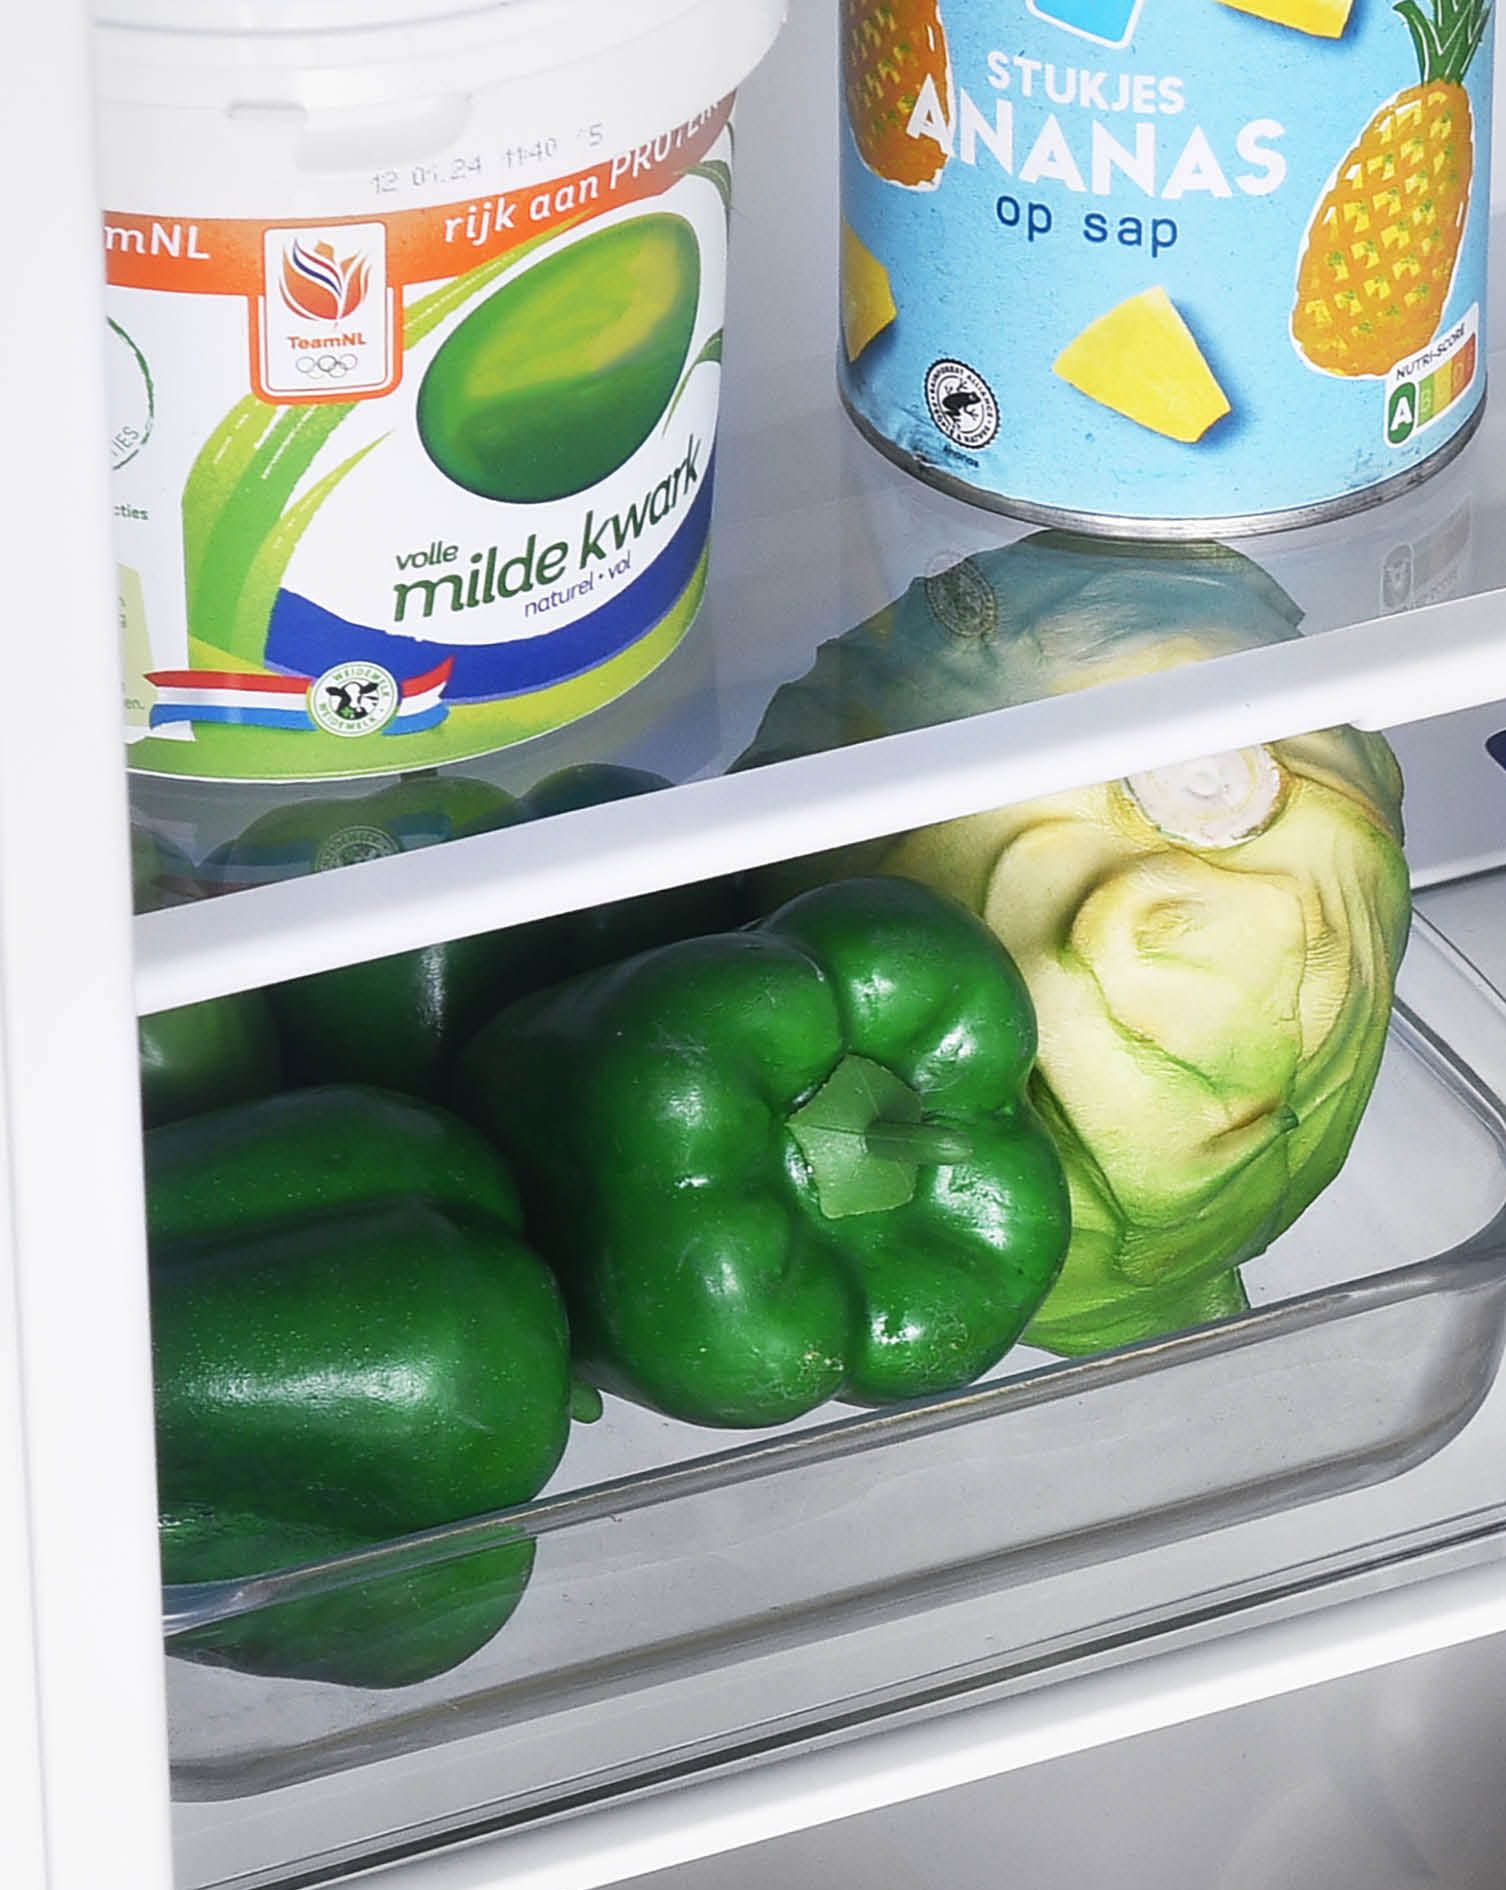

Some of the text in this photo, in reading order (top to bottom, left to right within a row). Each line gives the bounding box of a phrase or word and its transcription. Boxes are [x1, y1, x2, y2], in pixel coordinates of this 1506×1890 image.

[988, 51, 1184, 114] STUKJES
[906, 75, 1287, 199] ANANAS
[444, 197, 518, 246] rijk
[530, 173, 599, 221] aan
[996, 196, 1179, 257] op sap
[287, 332, 367, 351] TeamNL
[1389, 396, 1414, 432] A
[393, 433, 701, 622] milde kwark
[396, 540, 460, 571] volle
[524, 550, 632, 618] naturel vol
